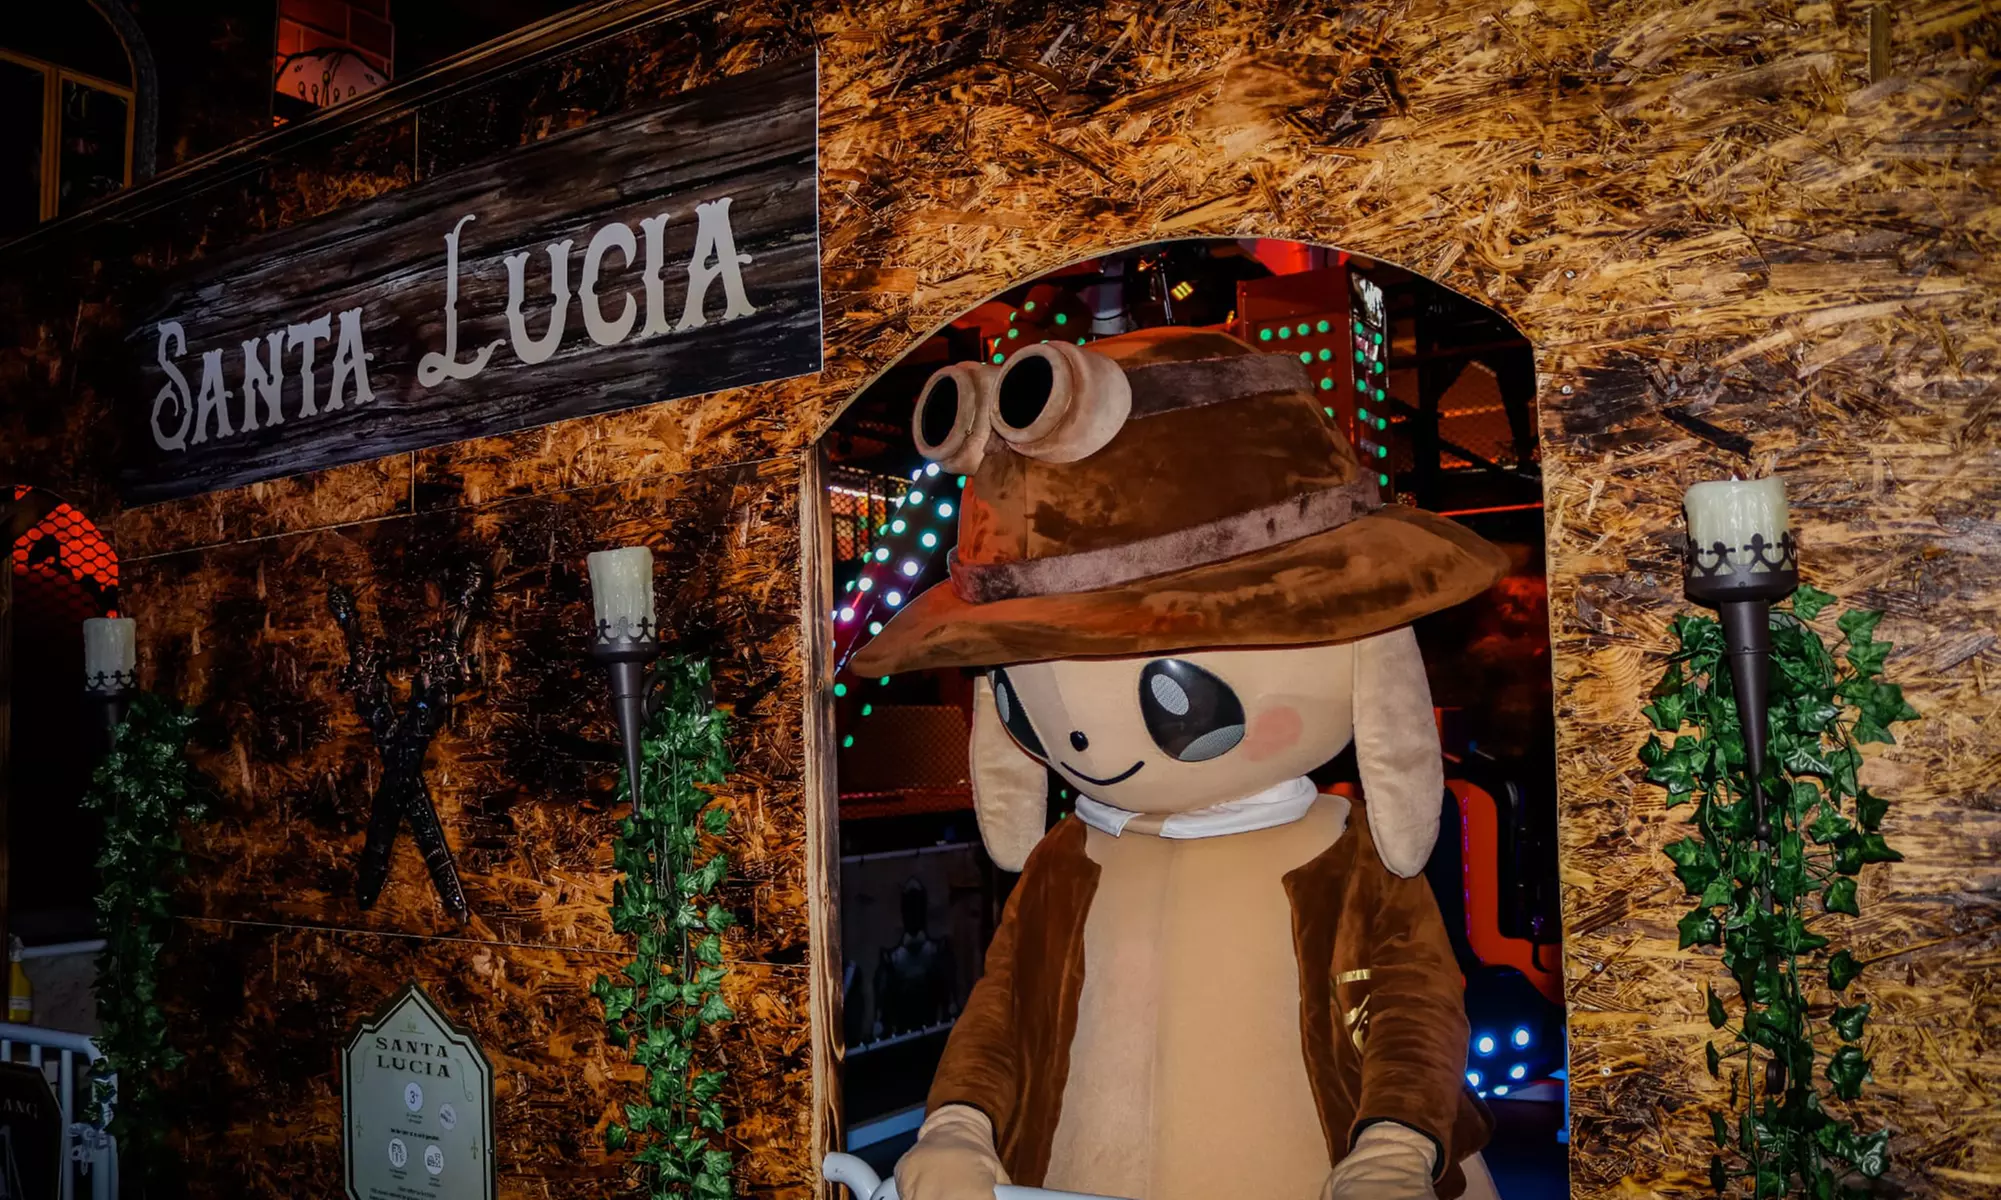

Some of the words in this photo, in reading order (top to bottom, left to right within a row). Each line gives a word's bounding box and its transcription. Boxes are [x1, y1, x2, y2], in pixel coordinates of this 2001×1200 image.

[150, 307, 376, 451] SANTA
[417, 196, 757, 388] LUCIA
[375, 1037, 449, 1058] SANTA
[377, 1055, 451, 1078] LUCIA
[0, 1097, 38, 1120] ANG
